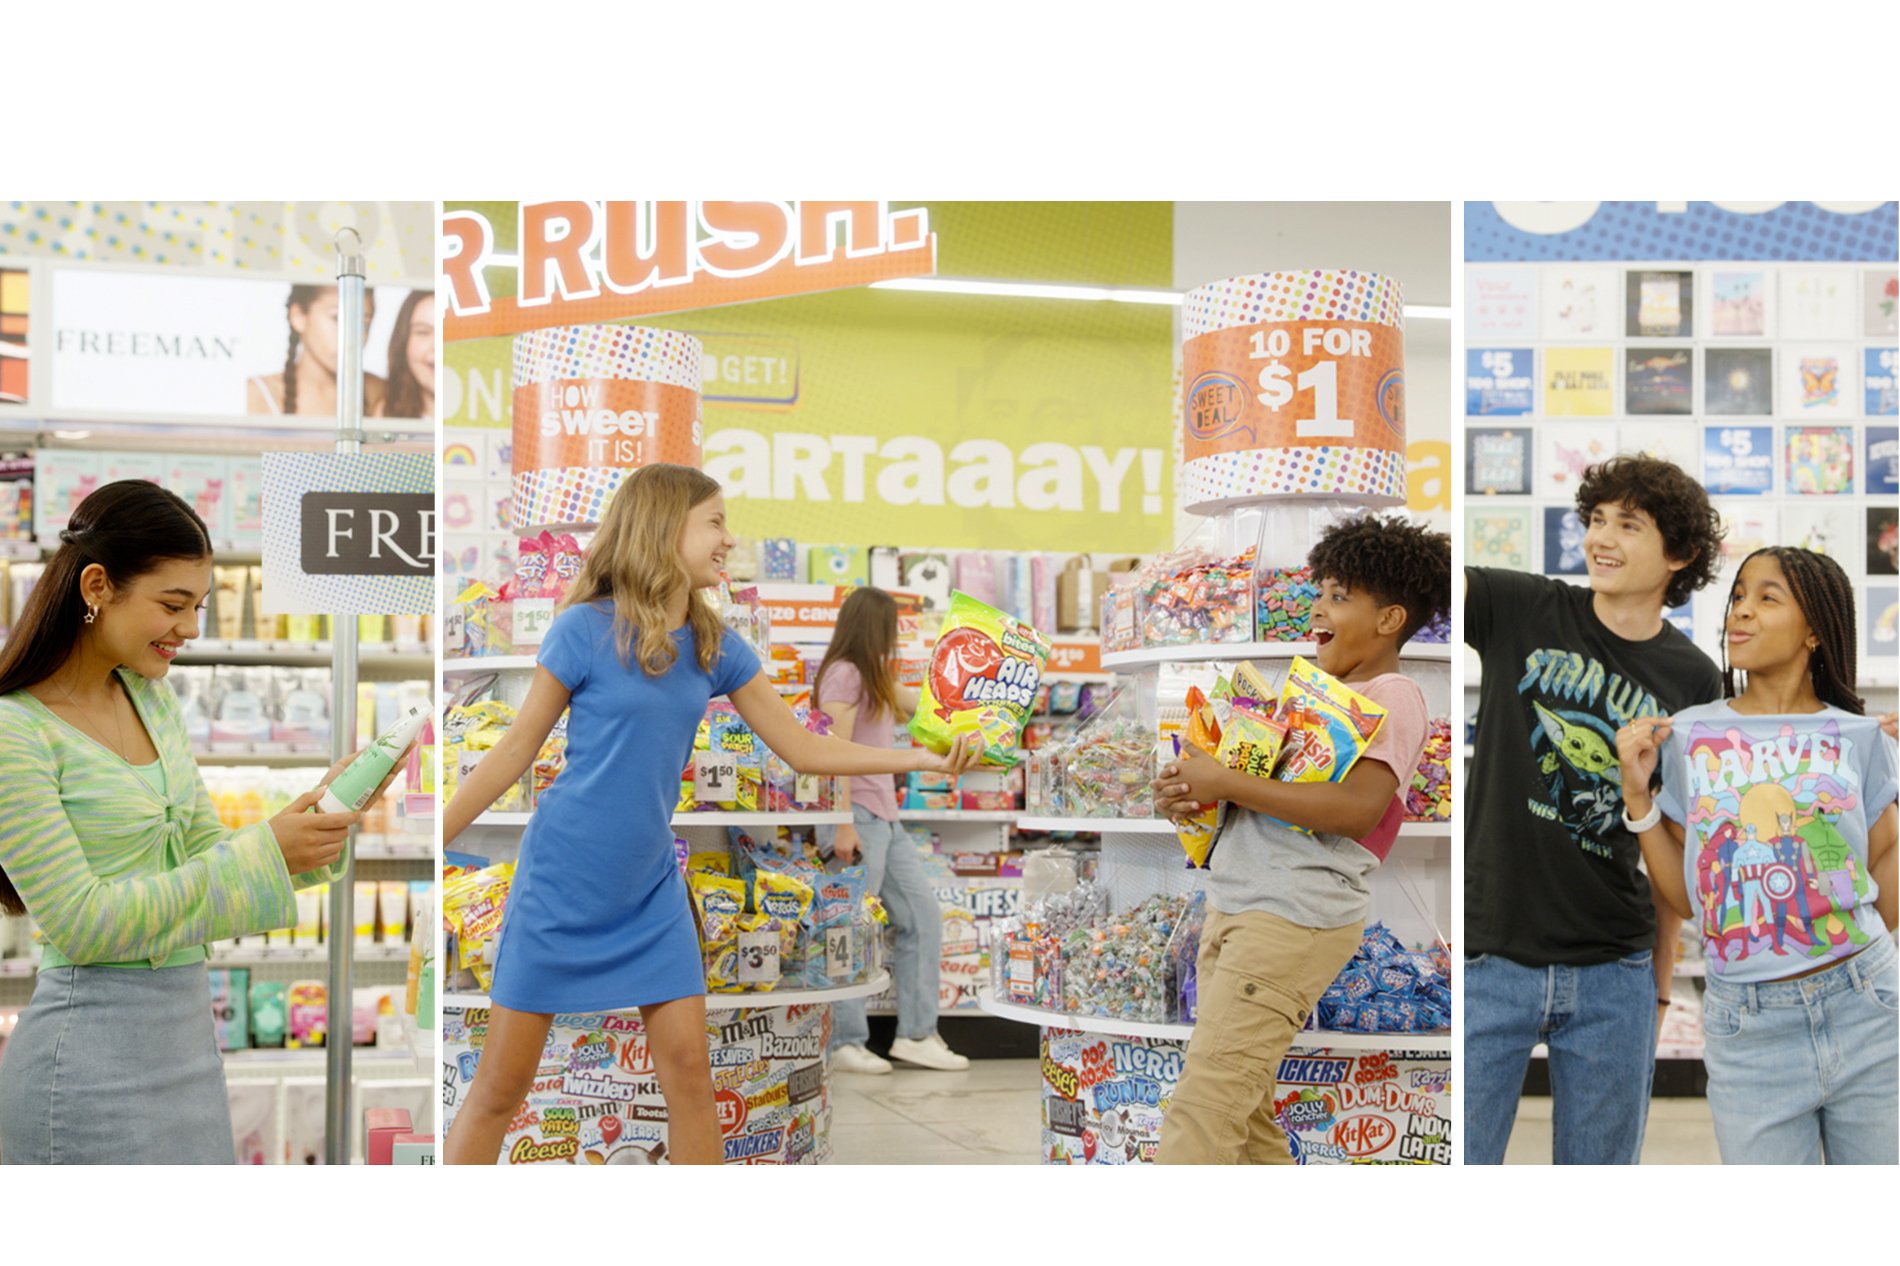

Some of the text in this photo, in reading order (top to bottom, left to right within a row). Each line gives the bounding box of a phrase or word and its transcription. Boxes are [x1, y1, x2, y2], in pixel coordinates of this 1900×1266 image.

[56, 329, 235, 360] FREEMAN
[1249, 328, 1372, 360] 10 FOR
[722, 356, 787, 386] GET!
[552, 385, 600, 408] HOW
[1191, 385, 1236, 411] SWEET
[1257, 360, 1354, 437] $1
[589, 440, 642, 463] IT IS!
[996, 655, 1040, 691] AIR
[963, 675, 1034, 708] HEADS
[1518, 648, 1669, 728] STAR WA
[721, 732, 753, 745] SOUR
[1249, 747, 1265, 776] SOU
[1684, 731, 1859, 797] MARVEL
[829, 935, 849, 967] $4
[576, 1042, 609, 1055] JOLLY
[760, 1032, 821, 1059] Bazooka
[1081, 1041, 1107, 1068] POP
[1080, 1058, 1117, 1090] ROCKS
[1354, 1064, 1399, 1084] ROCKS
[1358, 1053, 1390, 1070] POP
[561, 1073, 637, 1101] Twizzlers
[1092, 1075, 1161, 1113] RUNTS
[543, 1107, 576, 1121] SOUR
[636, 1106, 669, 1120] Tootsi
[1289, 1100, 1325, 1117] JOLLY
[1290, 1111, 1329, 1124] rancher
[540, 1119, 581, 1134] PATCH
[511, 1136, 579, 1164] Reese's
[723, 1129, 783, 1160] SNICKERS
